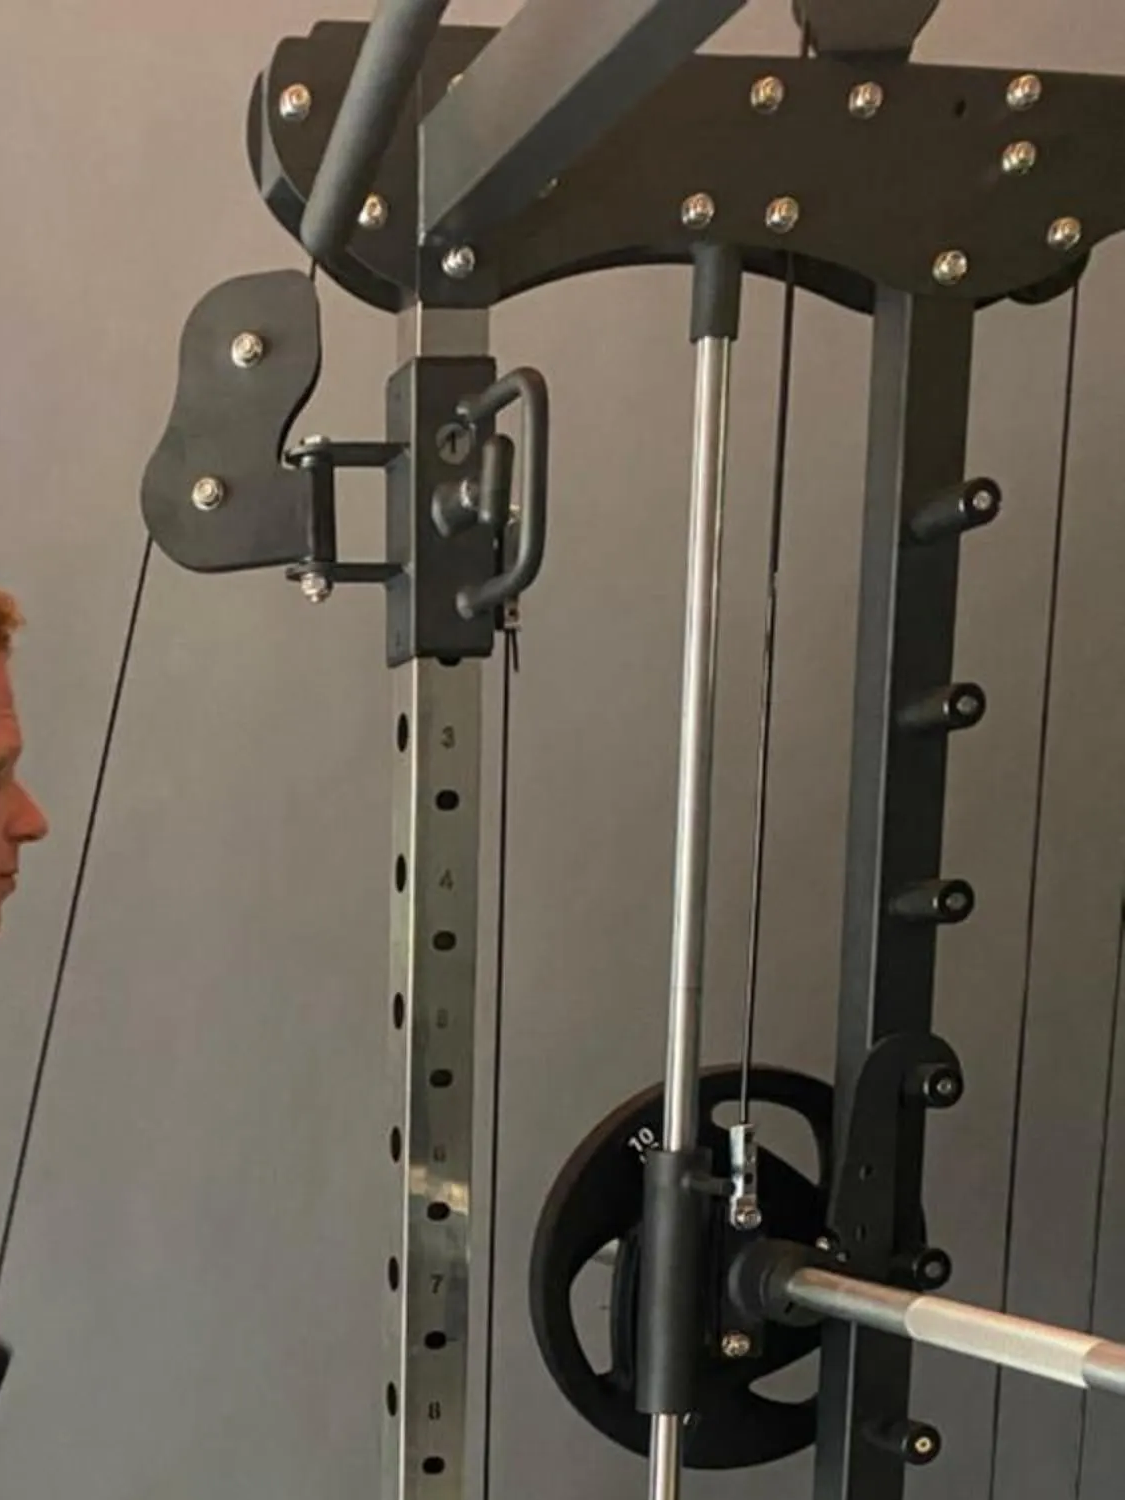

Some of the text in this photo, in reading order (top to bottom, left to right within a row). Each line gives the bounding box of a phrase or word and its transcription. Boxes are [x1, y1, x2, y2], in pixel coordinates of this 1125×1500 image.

[440, 725, 456, 750] 3
[438, 868, 454, 891] 4
[627, 1127, 654, 1152] 10
[429, 1274, 445, 1295] 7
[427, 1401, 442, 1421] 8
